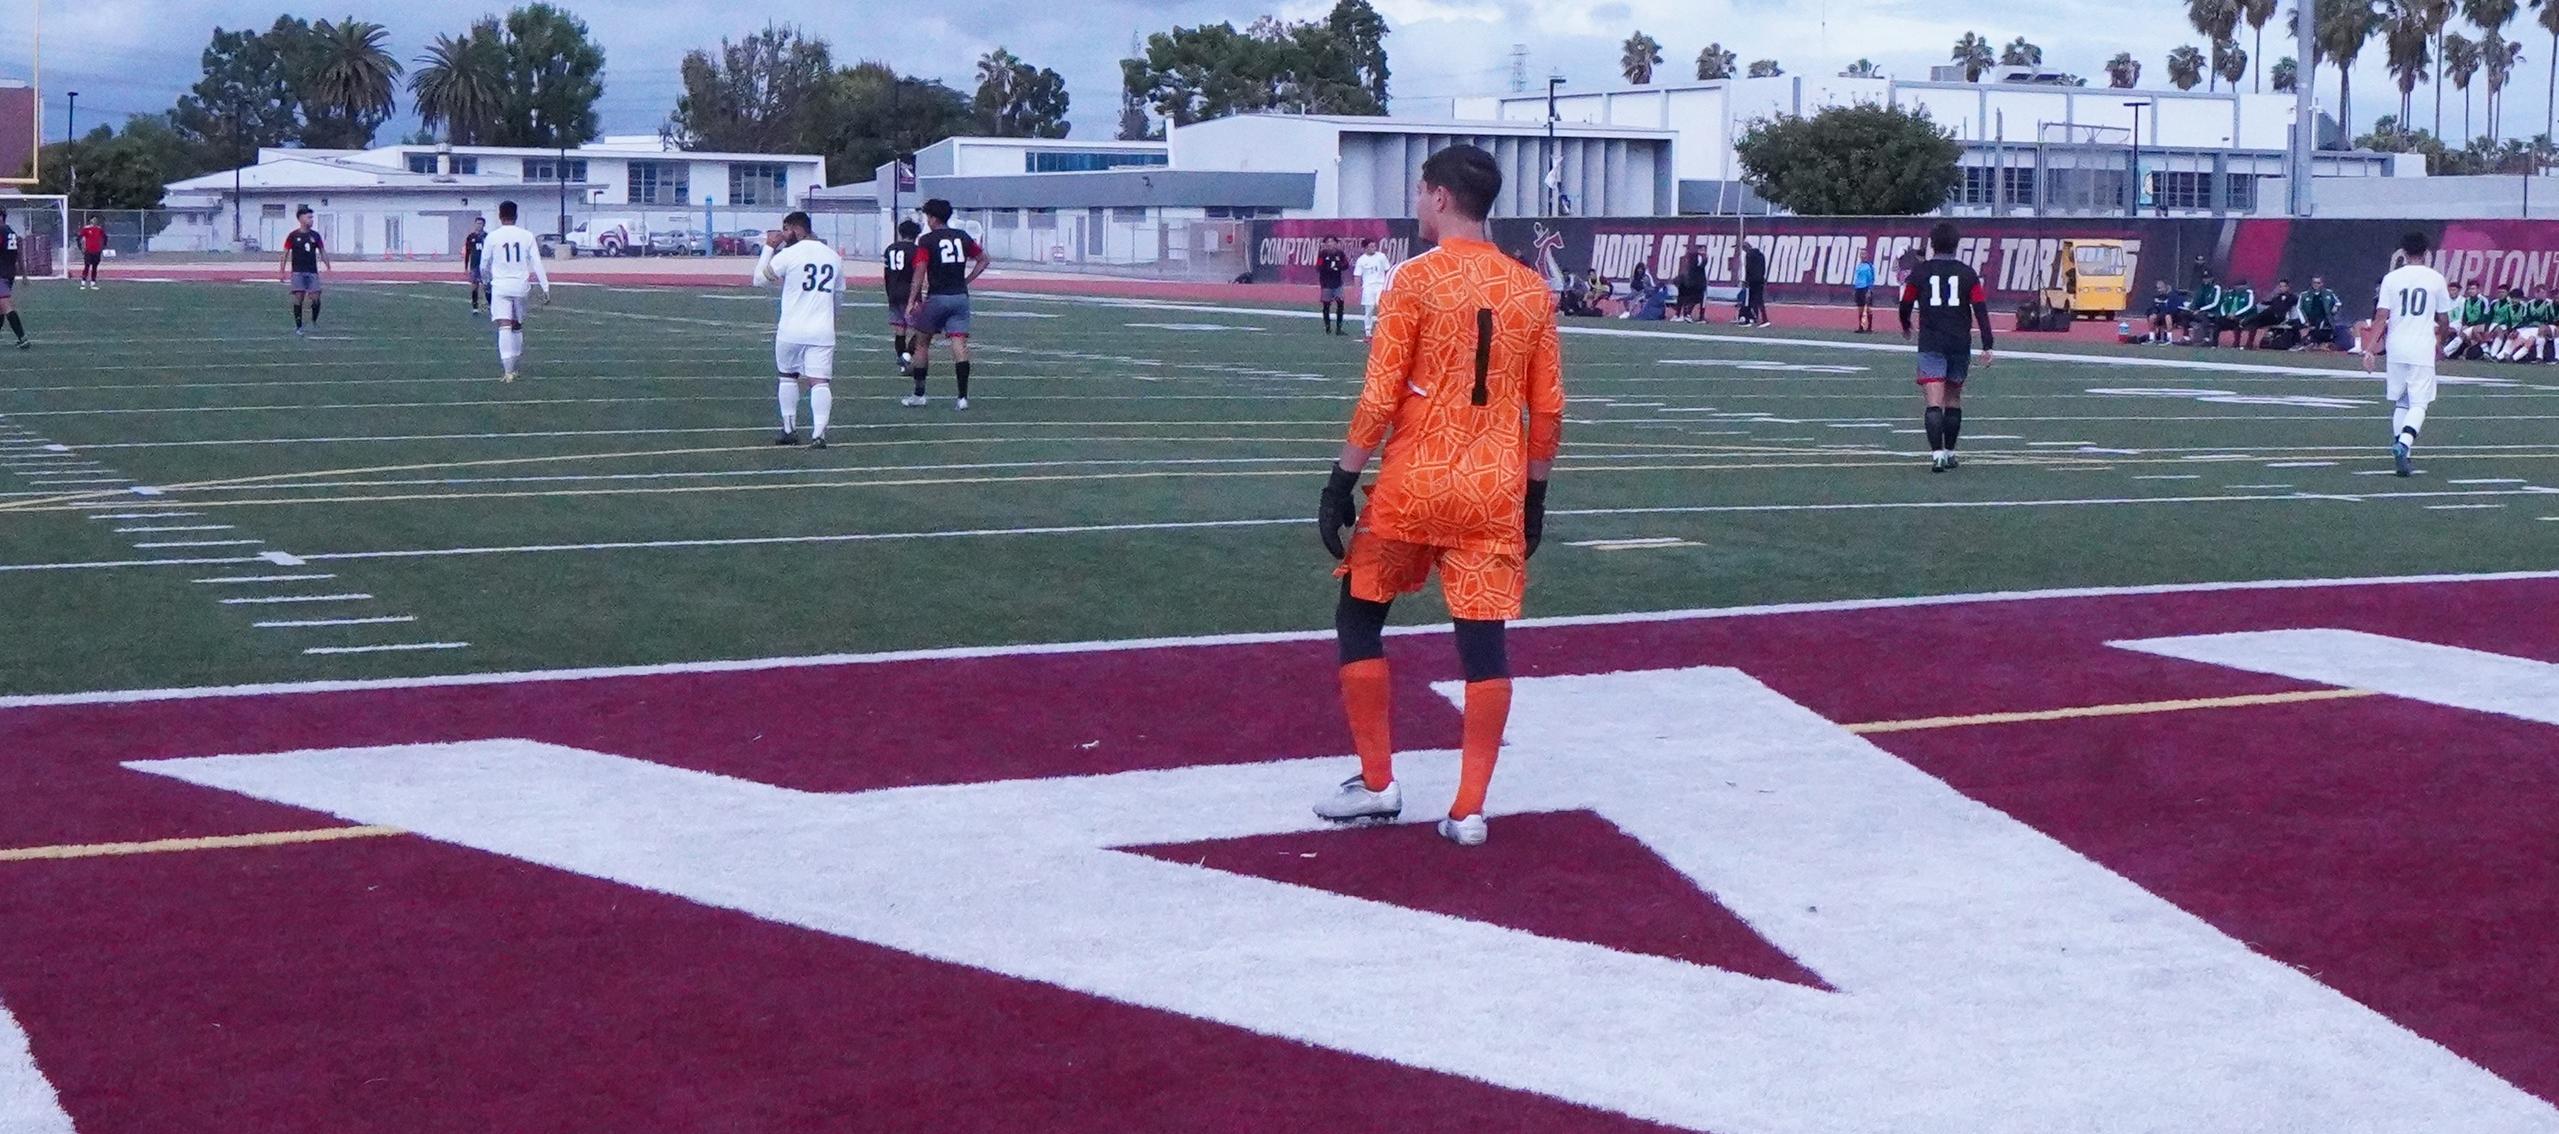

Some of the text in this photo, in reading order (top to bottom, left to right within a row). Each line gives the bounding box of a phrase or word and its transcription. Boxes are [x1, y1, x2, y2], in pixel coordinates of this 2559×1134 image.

[502, 241, 521, 263] 11
[889, 250, 905, 271] 19
[939, 238, 966, 264] 21
[1591, 234, 1655, 279] HOME
[1657, 235, 1689, 280] OF
[1744, 235, 1868, 285] OMPTON
[1873, 236, 1991, 287] COGE
[1997, 238, 2142, 294] TARS
[802, 263, 834, 293] 32
[1929, 275, 1960, 307] 11
[2399, 287, 2428, 317] 10
[1470, 308, 1493, 406] 1
